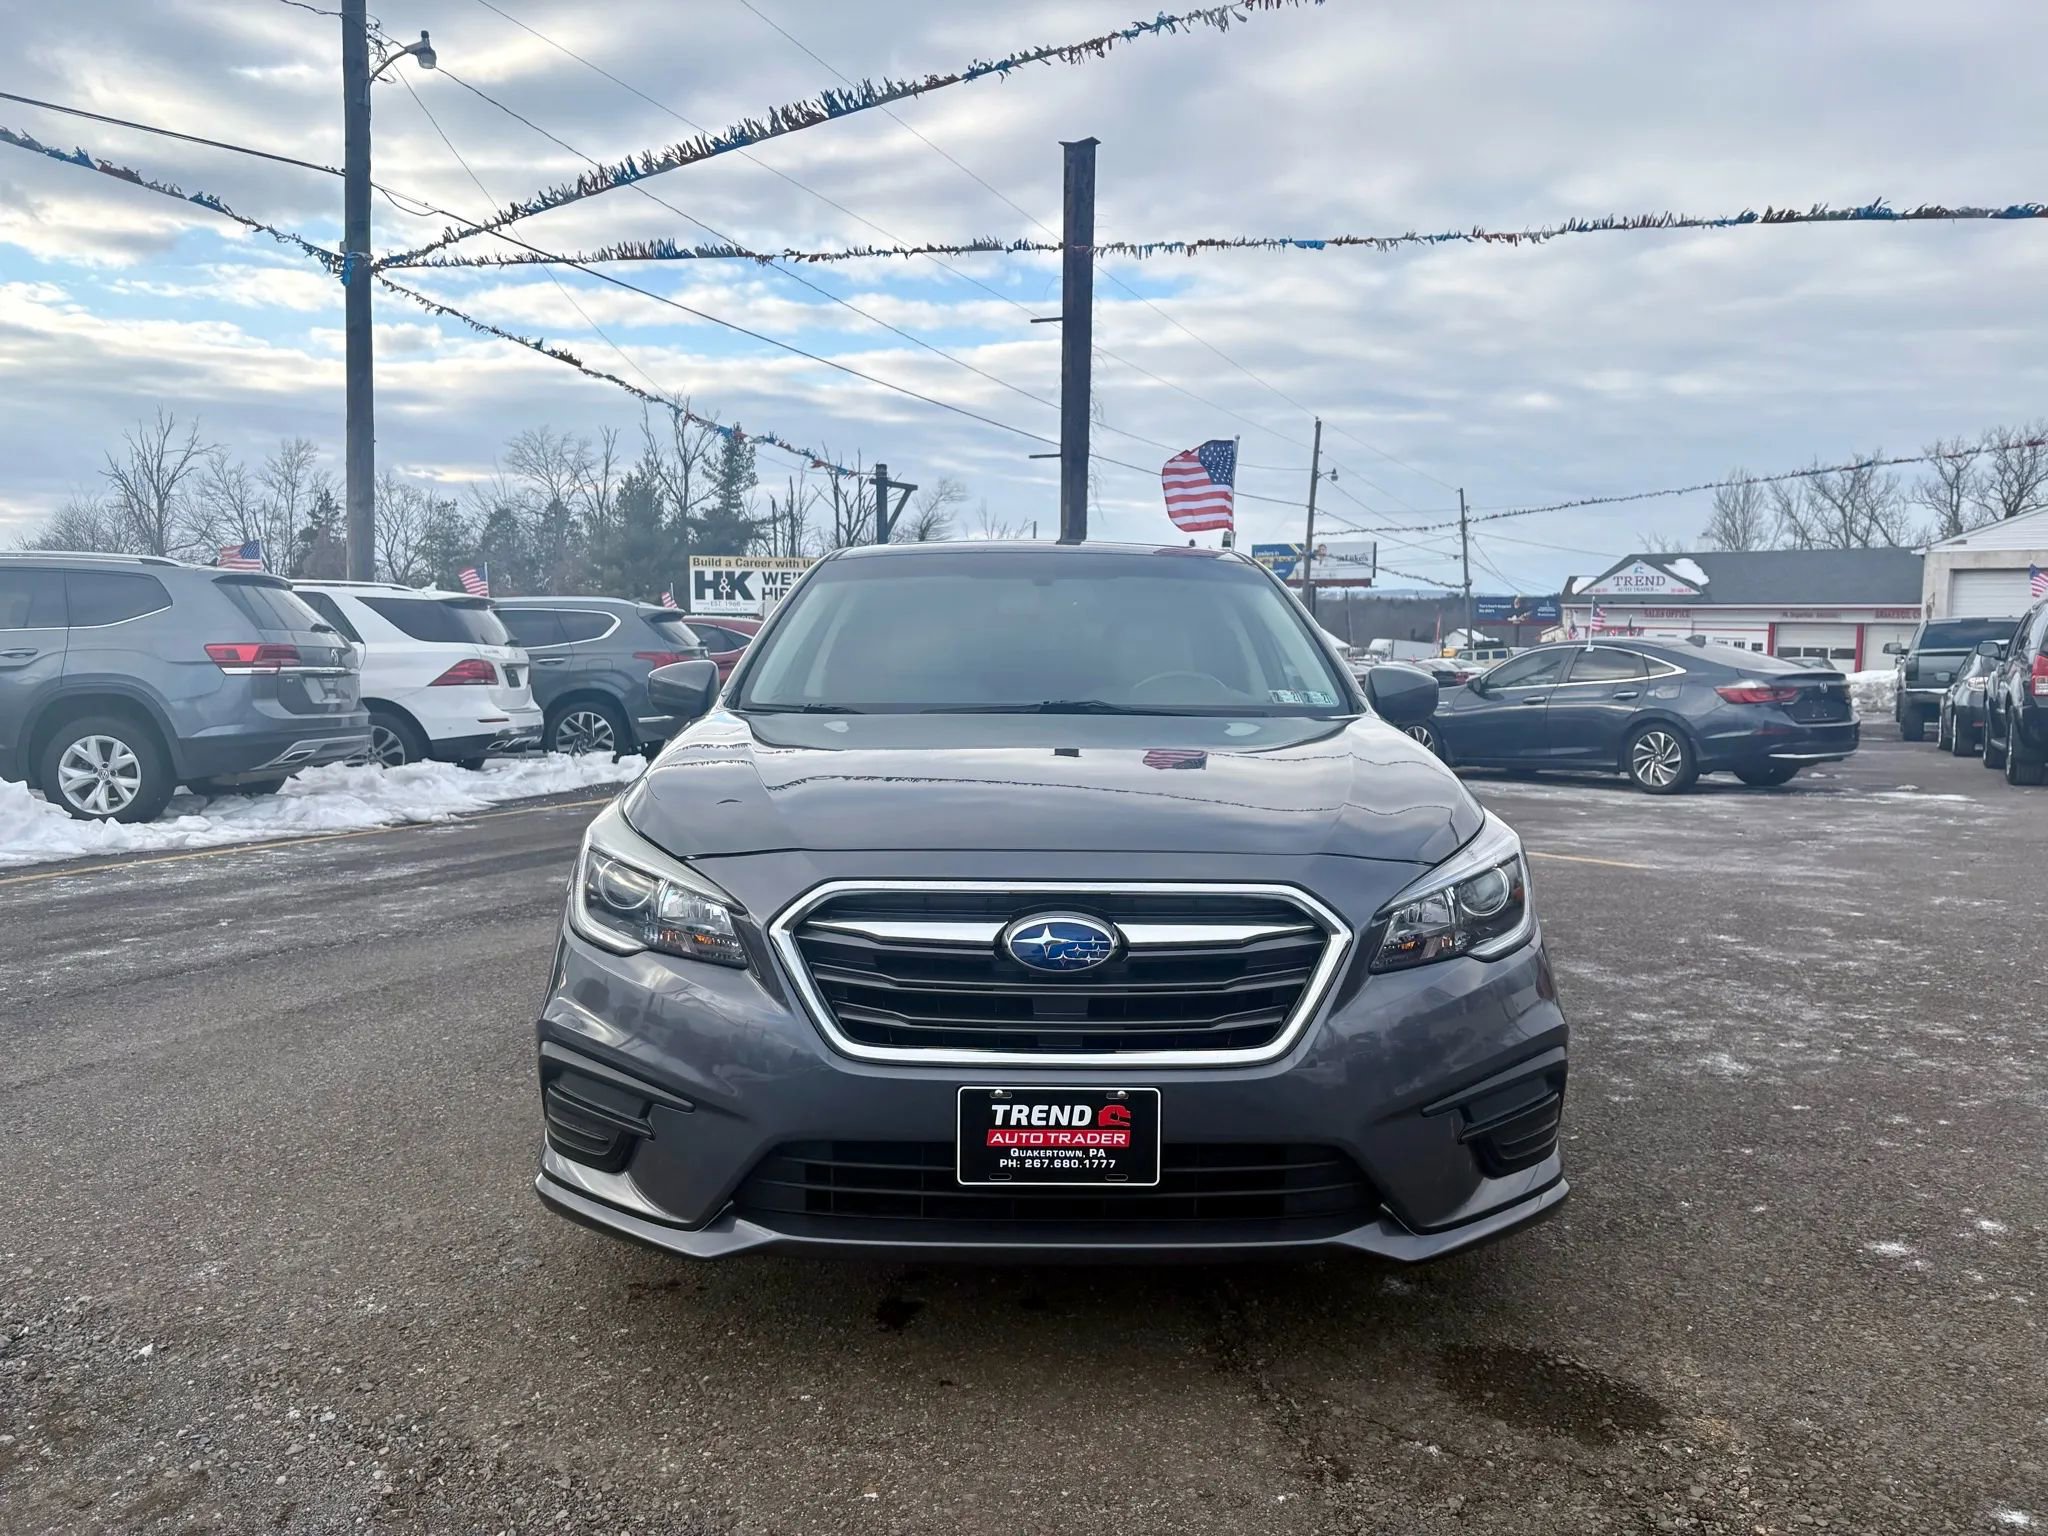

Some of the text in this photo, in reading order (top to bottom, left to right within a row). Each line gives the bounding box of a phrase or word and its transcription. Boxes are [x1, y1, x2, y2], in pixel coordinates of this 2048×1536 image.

[692, 557, 724, 567] Build
[735, 558, 771, 568] Career
[775, 559, 799, 568] with
[694, 570, 756, 600] H&K
[1613, 575, 1666, 586] TREND
[991, 1104, 1092, 1126] TREND
[990, 1133, 1126, 1144] AUTO TRADER
[1089, 1149, 1106, 1157] PA
[1000, 1159, 1116, 1169] PH: 267.680.1777
